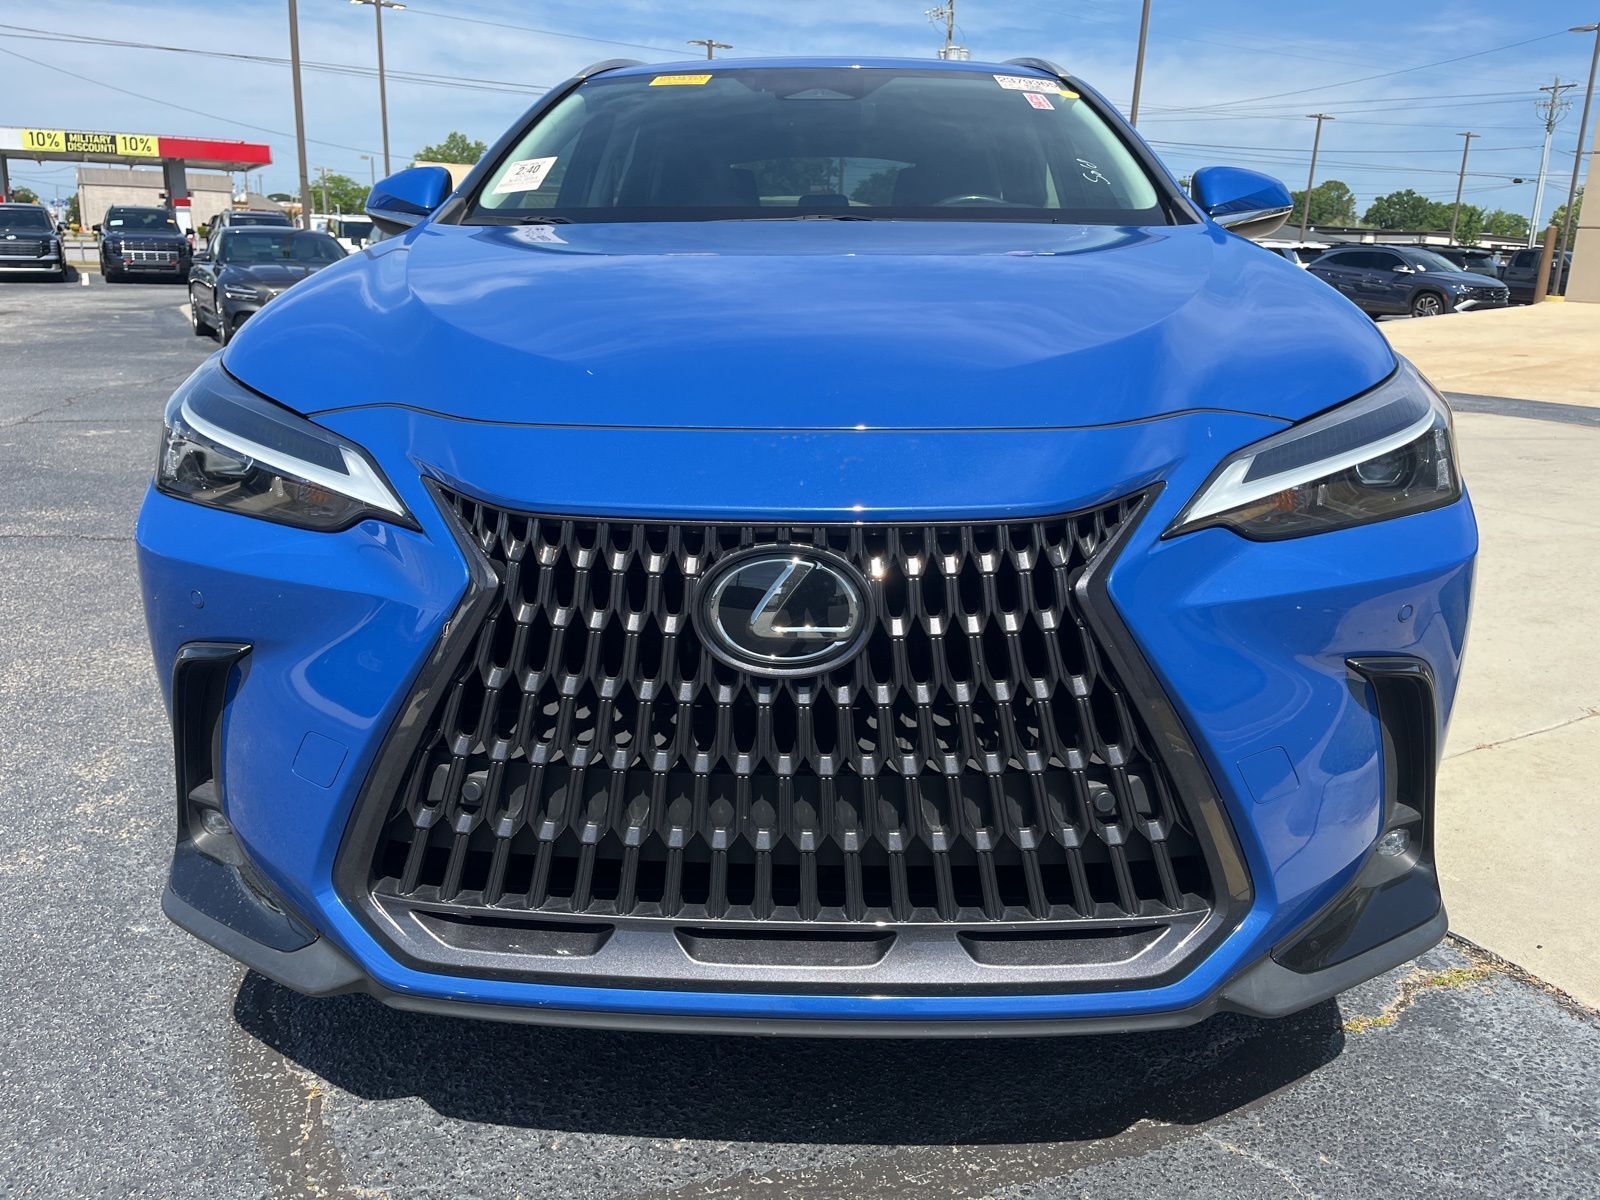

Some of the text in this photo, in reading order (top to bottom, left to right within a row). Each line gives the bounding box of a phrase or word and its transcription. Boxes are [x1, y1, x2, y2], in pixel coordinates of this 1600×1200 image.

[28, 131, 60, 147] 10%
[68, 133, 112, 144] MILITARY
[121, 136, 152, 152] 10%
[515, 165, 541, 176] 2:40
